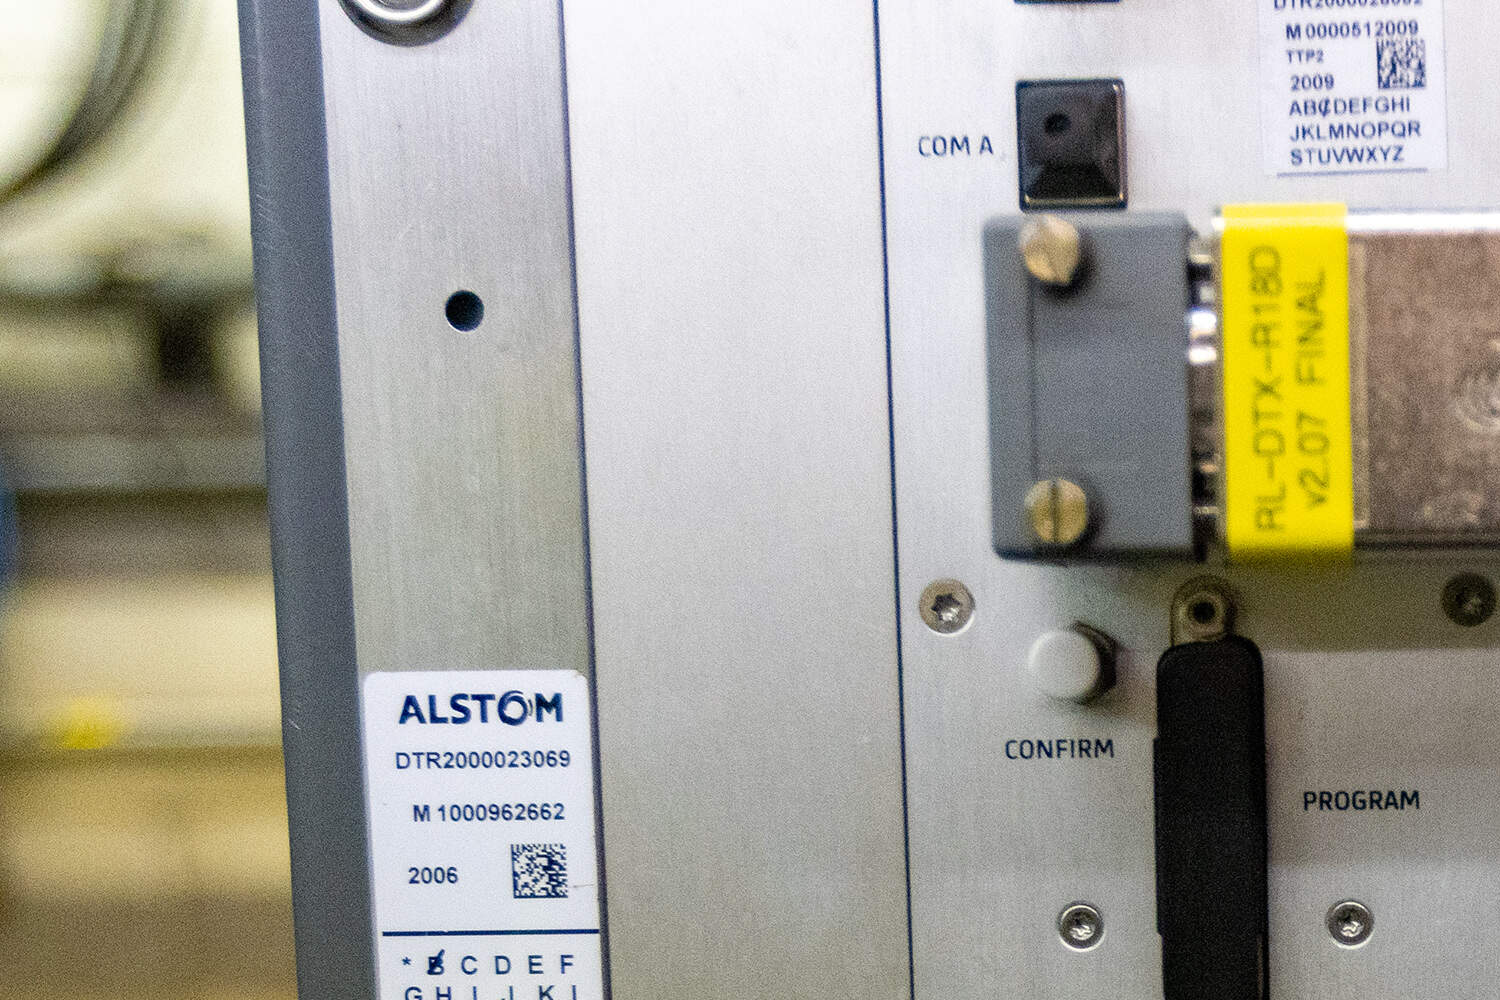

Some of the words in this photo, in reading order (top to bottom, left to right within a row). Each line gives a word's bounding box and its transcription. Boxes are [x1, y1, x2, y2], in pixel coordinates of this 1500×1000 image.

[1286, 49, 1324, 63] TTP2
[1290, 74, 1335, 92] 2009
[1290, 120, 1422, 142] JKLMNOPQR
[917, 135, 972, 157] COM
[978, 135, 995, 156] A
[1290, 145, 1404, 166] STUVWXYZ
[1294, 268, 1326, 387] FINAL
[399, 690, 564, 726] ALSTOM
[395, 750, 571, 770] DTR2000023069
[1005, 739, 1114, 760] CONFIRM
[1303, 790, 1420, 811] PROGRAM
[408, 867, 459, 885] 2006
